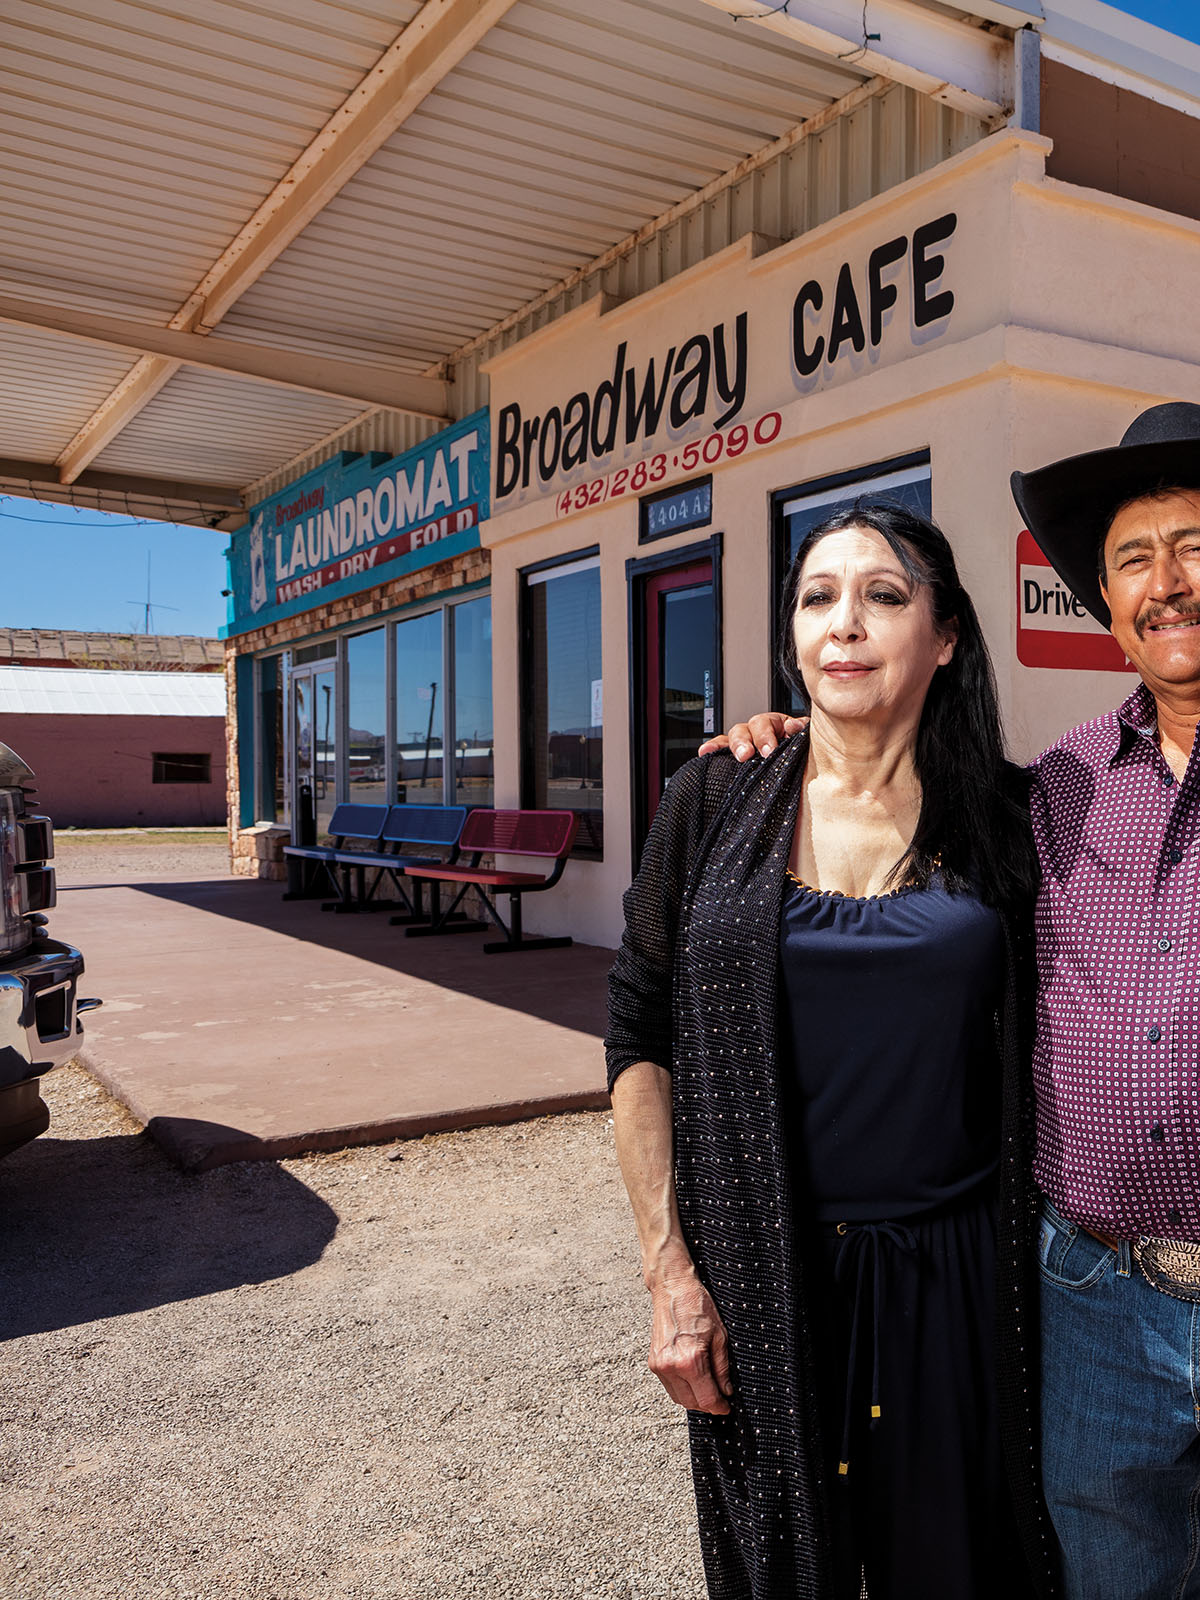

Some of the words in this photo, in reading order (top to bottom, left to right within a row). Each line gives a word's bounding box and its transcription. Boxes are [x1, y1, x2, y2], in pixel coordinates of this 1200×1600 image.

[496, 311, 748, 499] Broadway
[793, 213, 958, 376] CAFE
[275, 485, 325, 527] Broadway
[276, 430, 478, 582] LAUNDROMAT
[278, 571, 322, 603] WASH
[340, 547, 379, 579] DRY
[410, 508, 474, 551] FOLD
